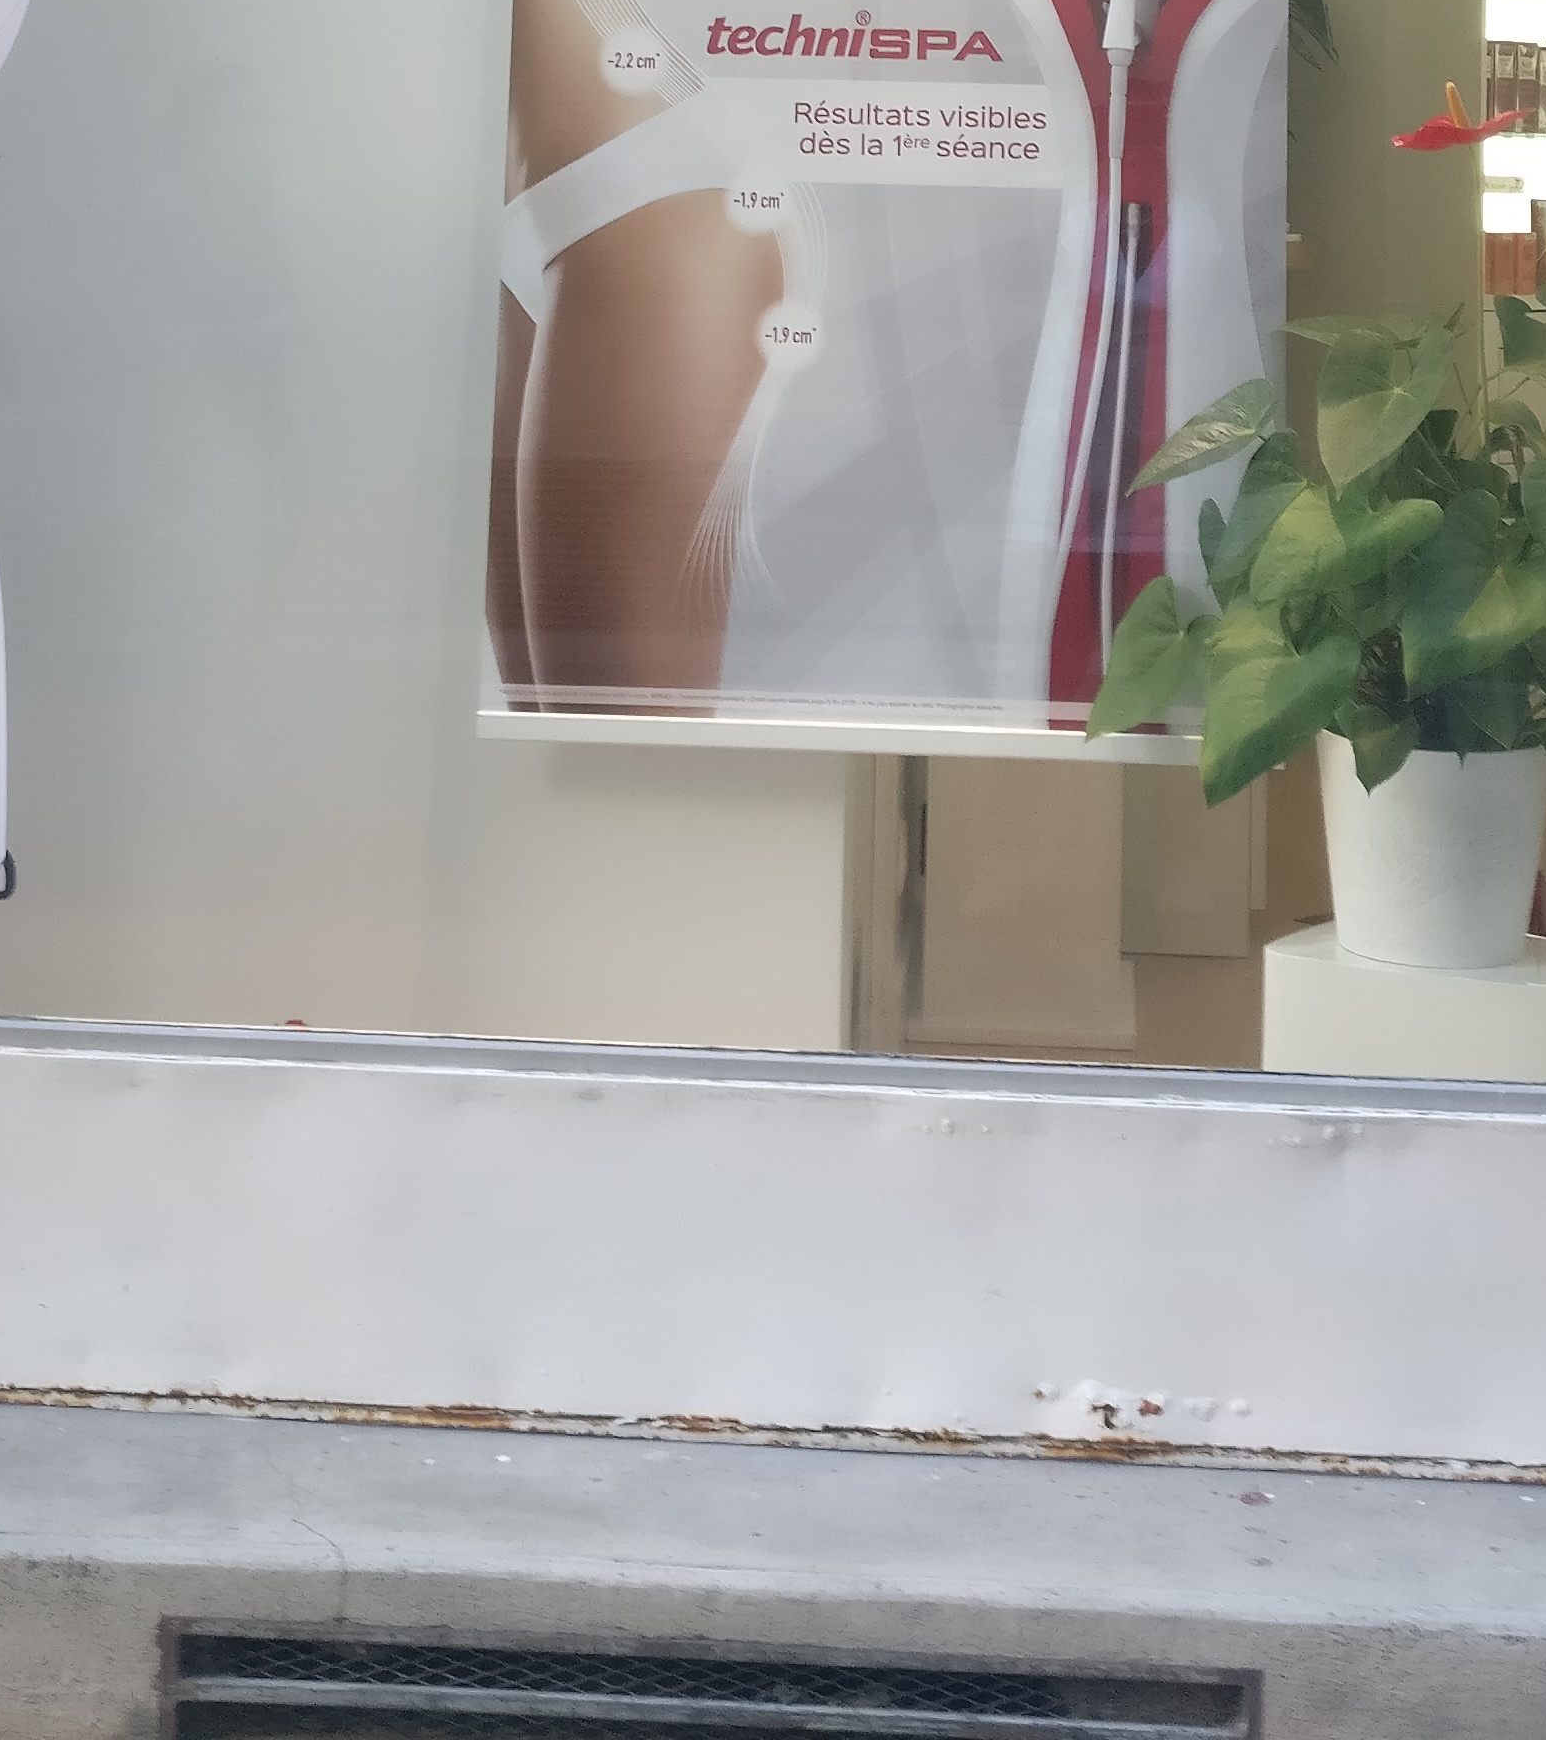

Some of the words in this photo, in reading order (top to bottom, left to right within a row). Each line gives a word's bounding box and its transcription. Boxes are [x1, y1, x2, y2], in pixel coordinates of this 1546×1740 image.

[794, 100, 931, 128] Résultats
[939, 104, 1048, 130] visibles
[799, 130, 851, 156] dès
[860, 133, 884, 157] la
[936, 134, 1041, 161] séance
